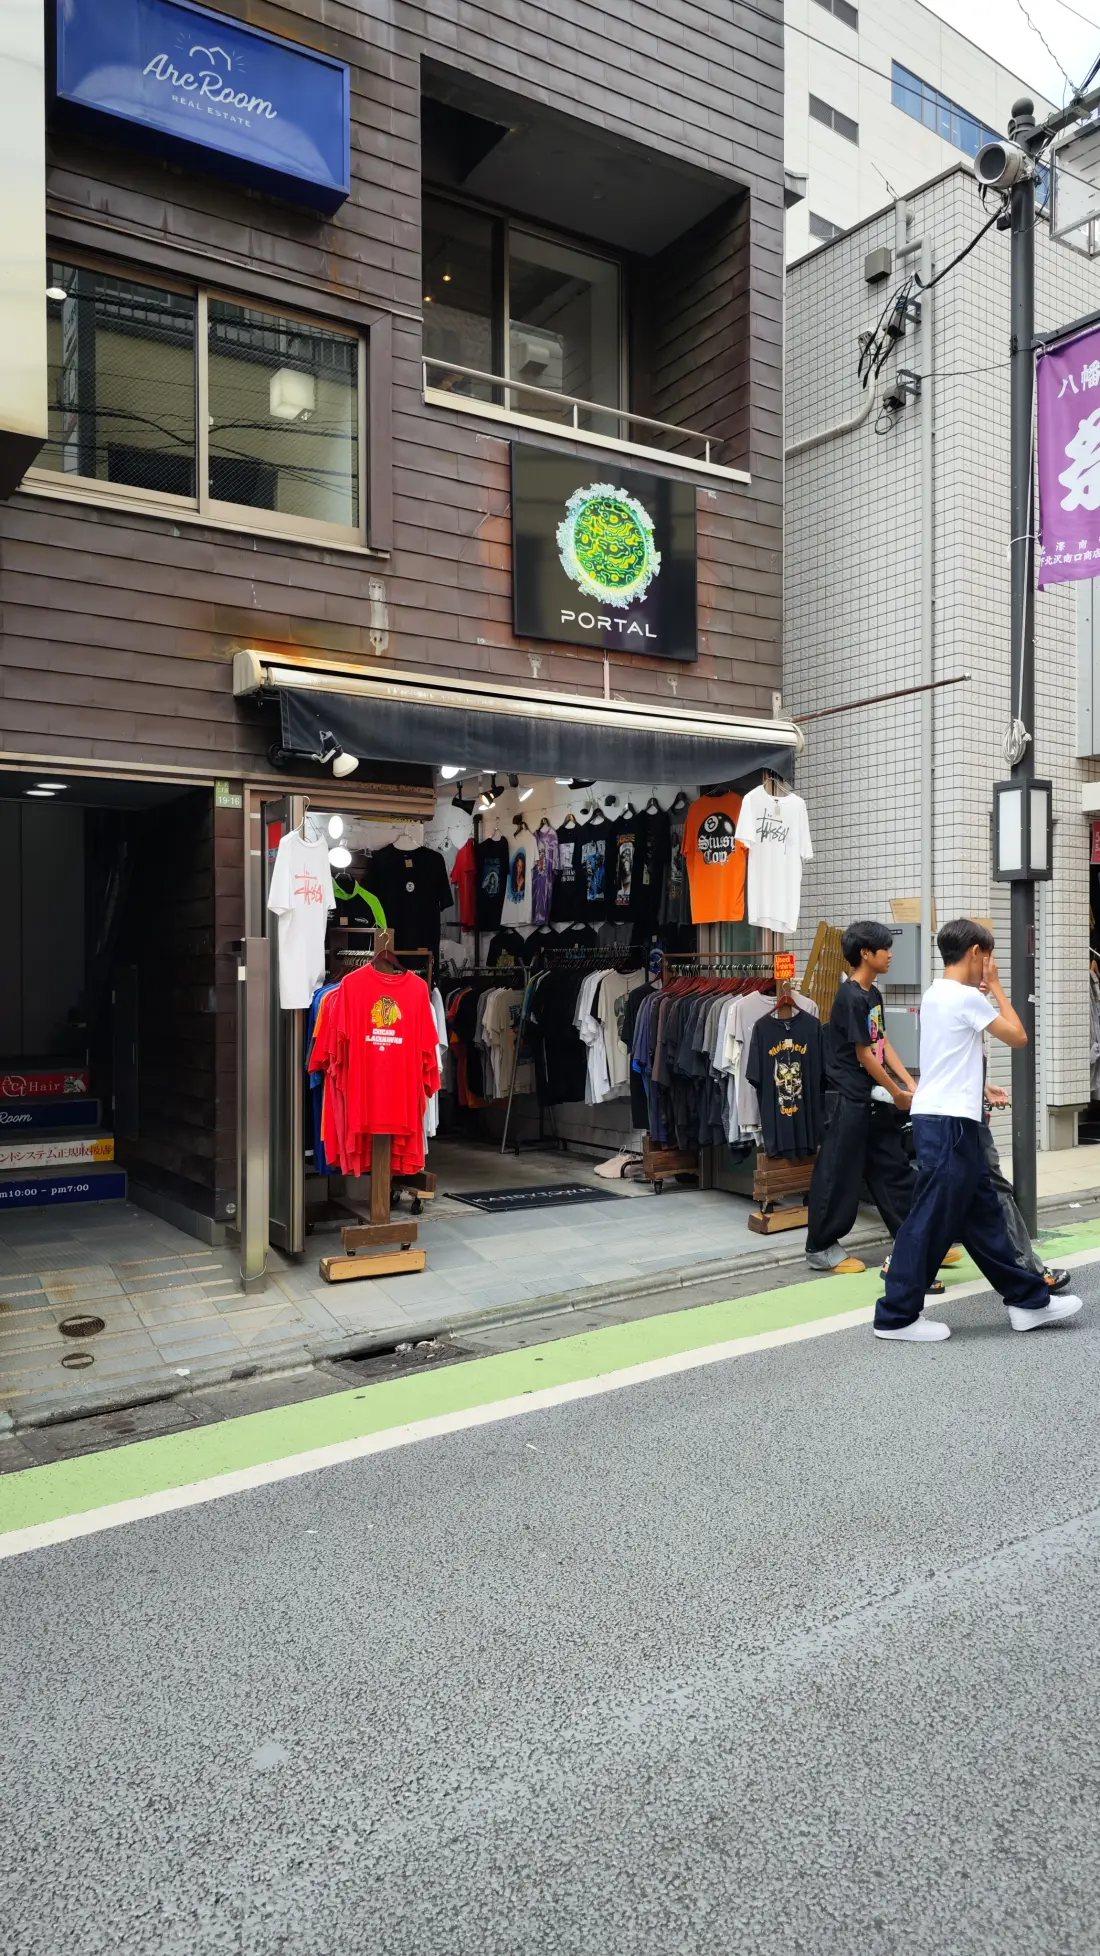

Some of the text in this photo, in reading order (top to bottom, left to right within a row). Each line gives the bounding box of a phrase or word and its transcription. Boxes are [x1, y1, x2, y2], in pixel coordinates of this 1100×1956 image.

[171, 94, 252, 128] REAL ESTATE
[560, 609, 657, 639] PORTAL
[218, 796, 240, 806] 19-16
[707, 817, 716, 830] 8
[29, 1081, 60, 1093] Hair
[51, 1183, 89, 1196] pm7:00
